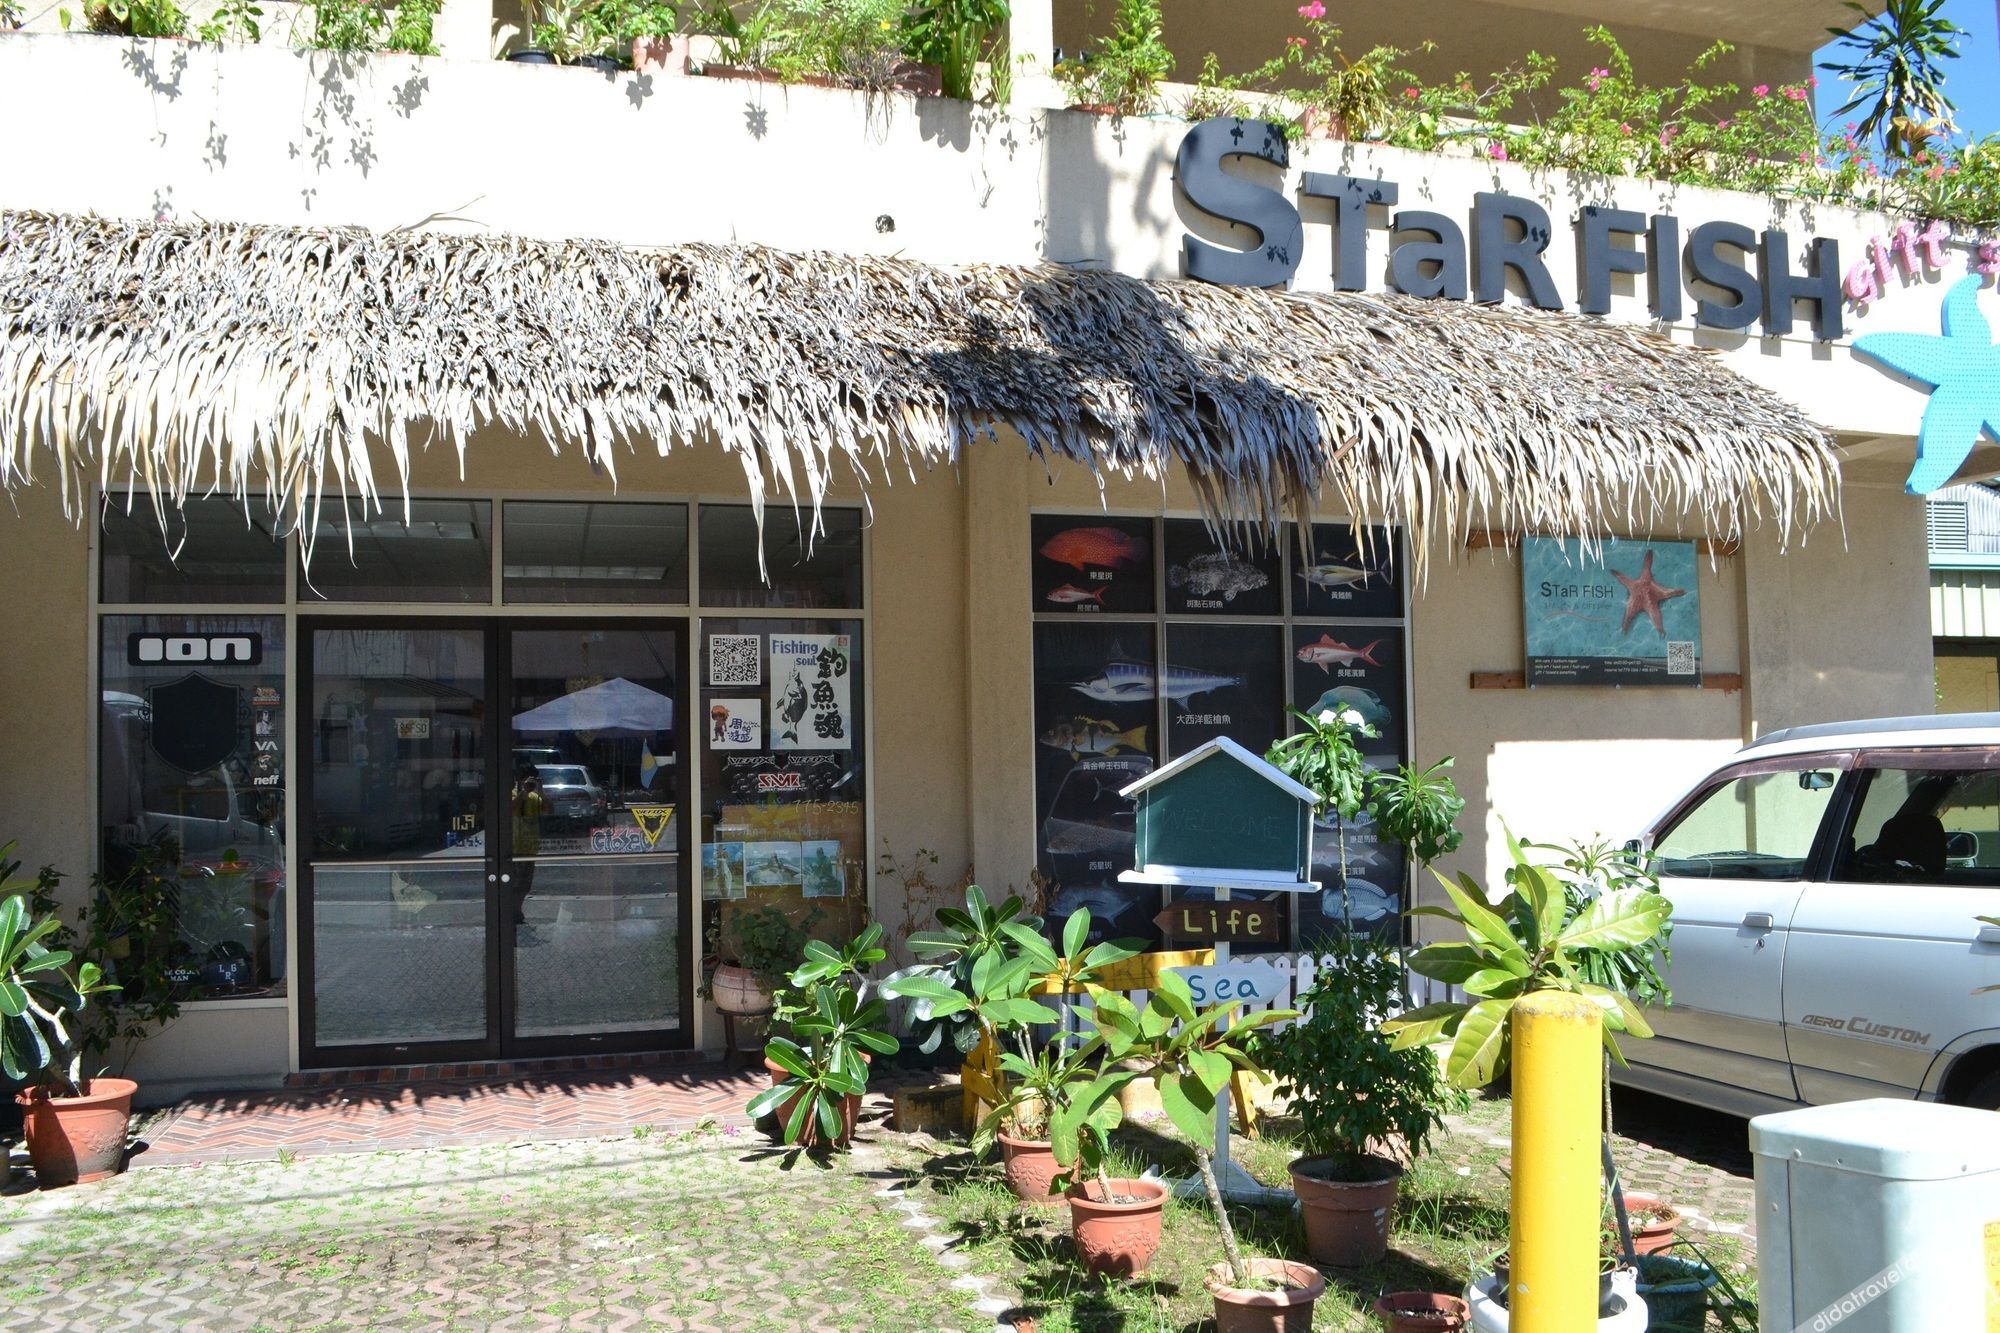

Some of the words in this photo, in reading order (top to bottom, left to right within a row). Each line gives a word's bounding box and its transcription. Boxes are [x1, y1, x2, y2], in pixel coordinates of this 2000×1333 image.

[1577, 204, 1844, 339] FISH
[1583, 584, 1614, 598] FISH
[771, 639, 819, 655] Fishing
[795, 655, 818, 666] soul
[811, 647, 848, 739] 釣魚魂
[253, 775, 280, 785] neff
[1183, 909, 1262, 935] Life
[1187, 976, 1260, 1001] Sea
